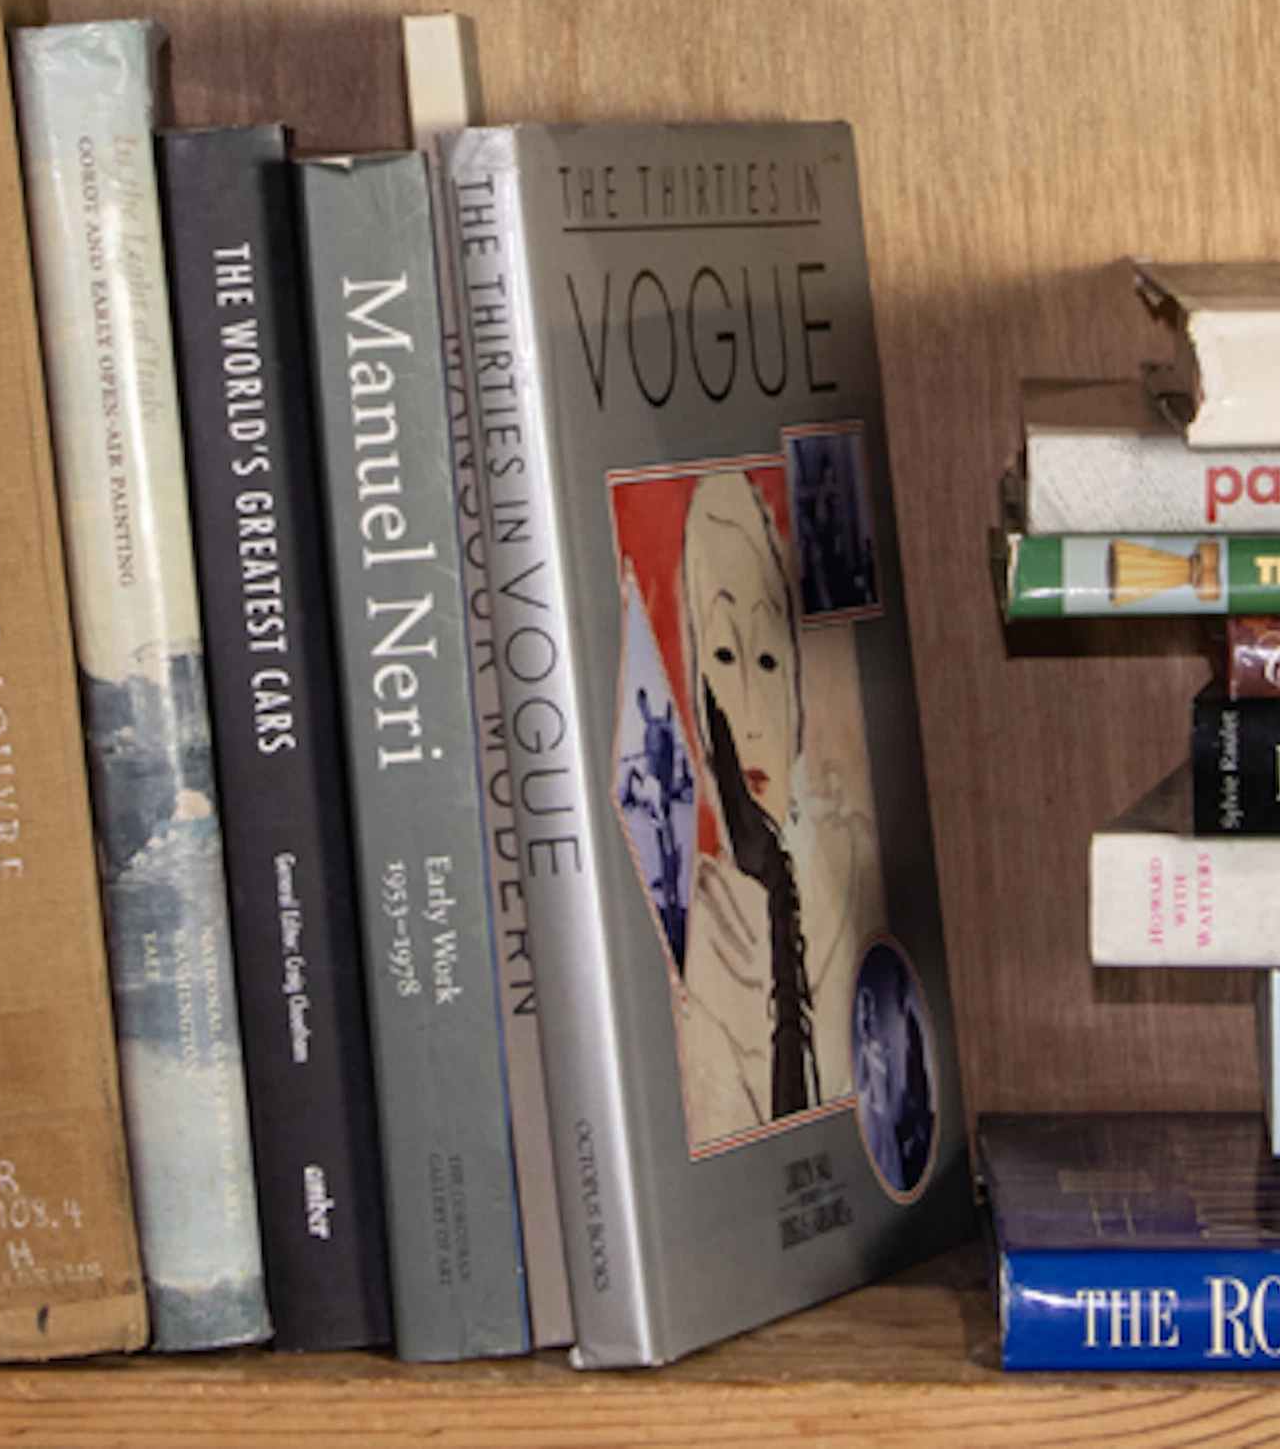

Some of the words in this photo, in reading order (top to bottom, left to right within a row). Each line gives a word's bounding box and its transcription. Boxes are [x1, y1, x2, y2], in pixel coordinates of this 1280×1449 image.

[78, 136, 100, 212] COROT
[559, 166, 617, 219] THE
[638, 163, 780, 218] THIRTIES
[794, 163, 821, 214] IN
[86, 221, 103, 273] AND
[457, 174, 498, 258] THE
[94, 279, 112, 347] EARLY
[567, 263, 838, 411] VOGUE
[99, 354, 126, 467] OPEN-AIR
[468, 272, 526, 479] THIRTIES
[342, 271, 437, 569] Manuel
[108, 477, 137, 587] PAINTING
[494, 500, 531, 546] IN
[366, 592, 443, 770] Neri
[499, 560, 582, 877] VOGUE
[424, 855, 451, 924] Early
[430, 931, 464, 1005] Work
[575, 1119, 601, 1220] OCTOPUS
[586, 1224, 610, 1293] BOOKS
[1076, 1287, 1180, 1350] THE
